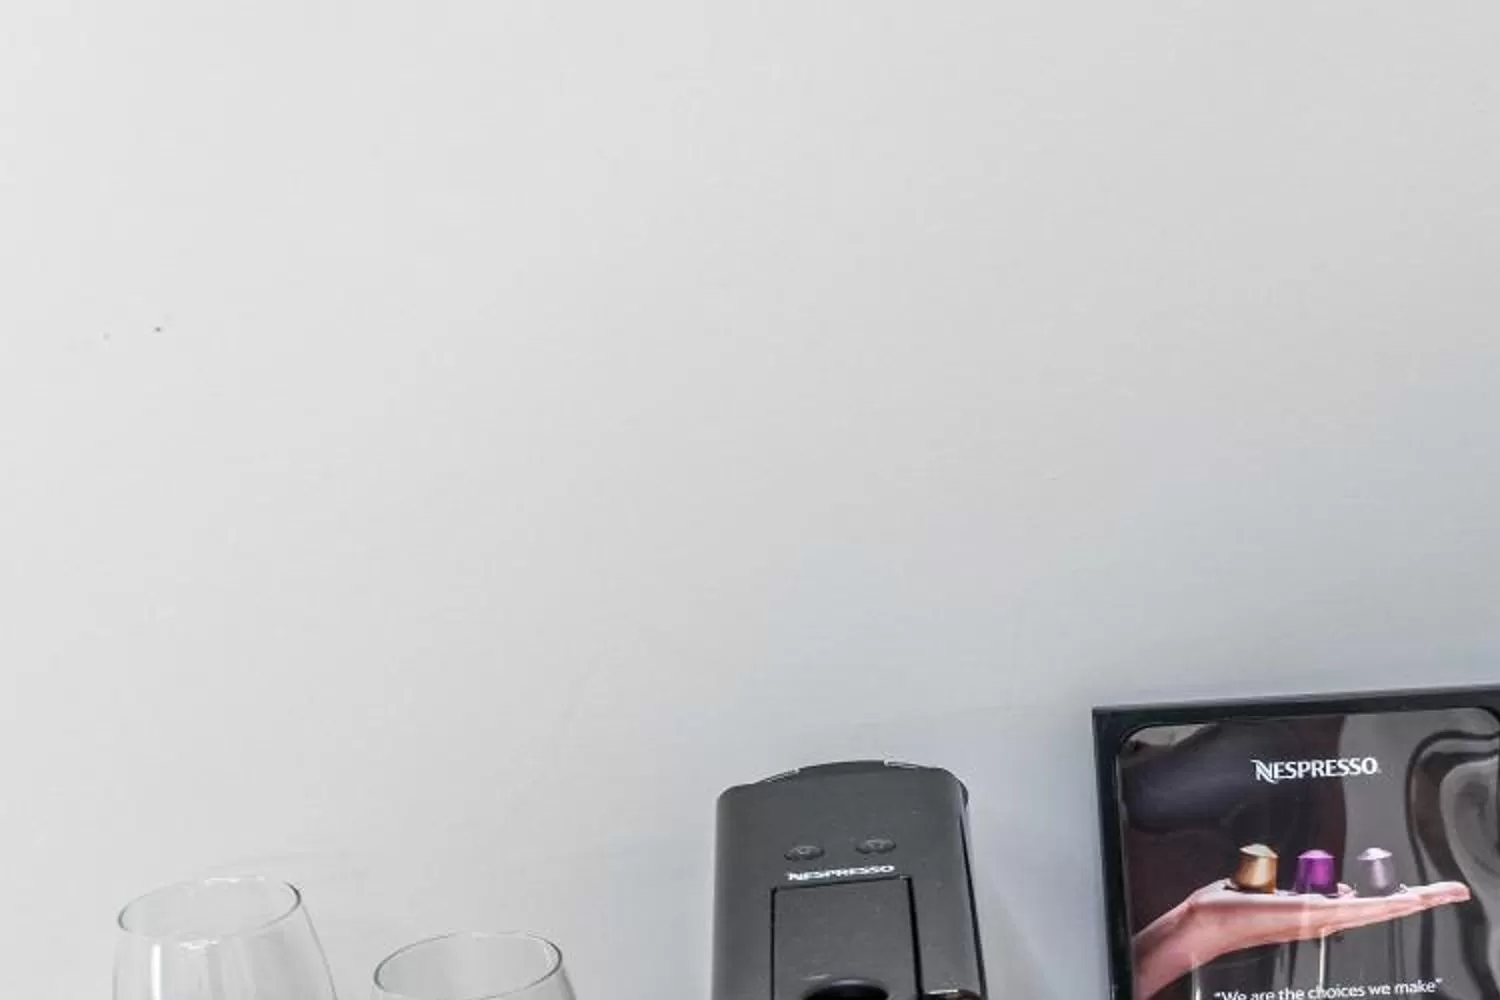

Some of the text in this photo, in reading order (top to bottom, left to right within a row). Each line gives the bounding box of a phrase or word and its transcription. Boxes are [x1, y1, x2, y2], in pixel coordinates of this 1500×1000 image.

[1250, 757, 1379, 784] NESPRESSO
[787, 865, 895, 881] NESPRESSO
[1278, 987, 1306, 1000] the
[1307, 984, 1366, 1000] choices
[1367, 985, 1391, 996] we
